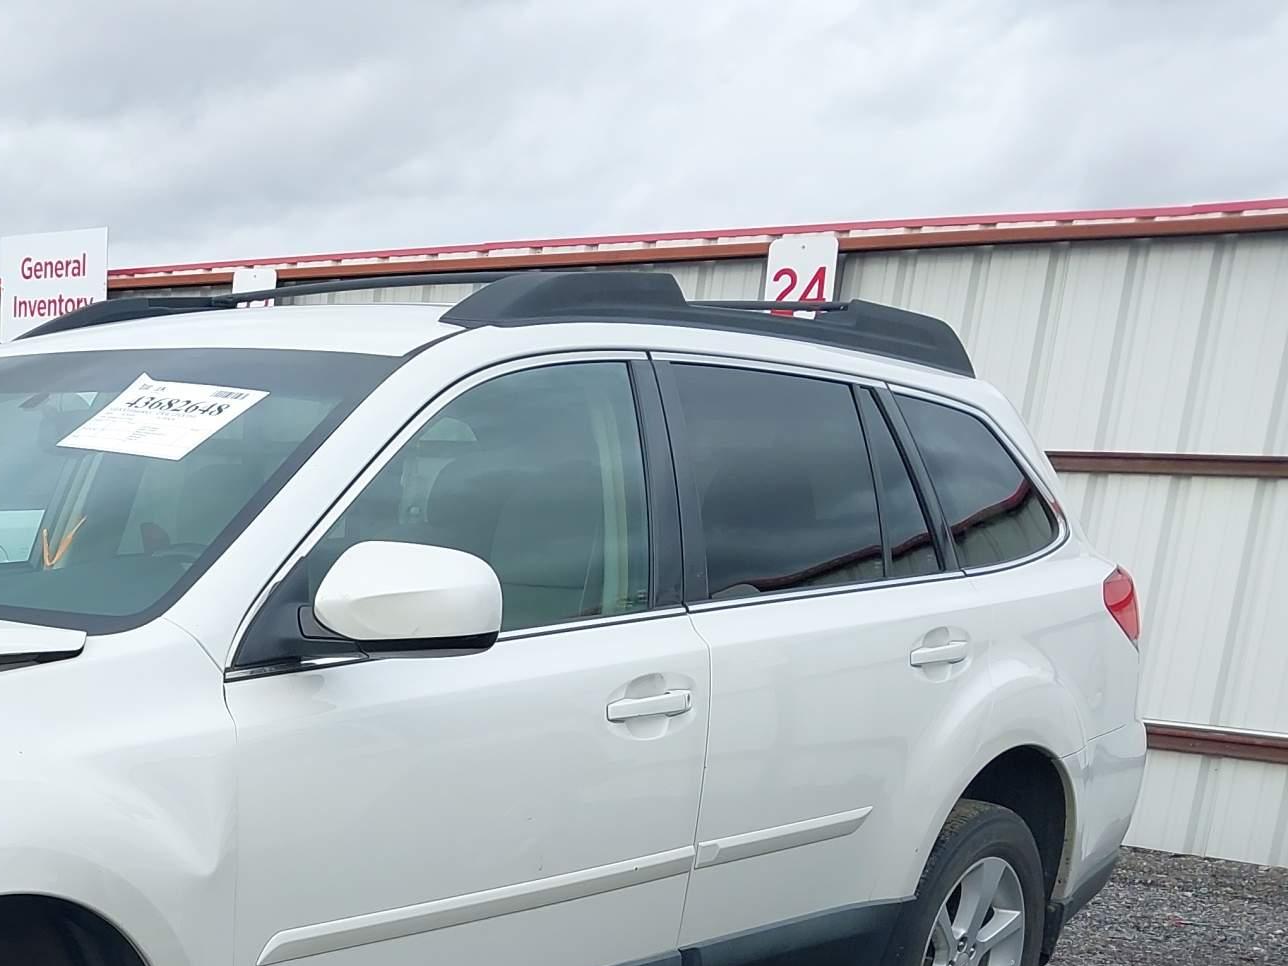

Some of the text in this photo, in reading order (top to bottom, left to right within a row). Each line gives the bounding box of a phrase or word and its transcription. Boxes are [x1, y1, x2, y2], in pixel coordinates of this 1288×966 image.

[21, 253, 86, 279] General
[773, 266, 826, 303] 24
[125, 395, 230, 416] 43682648
